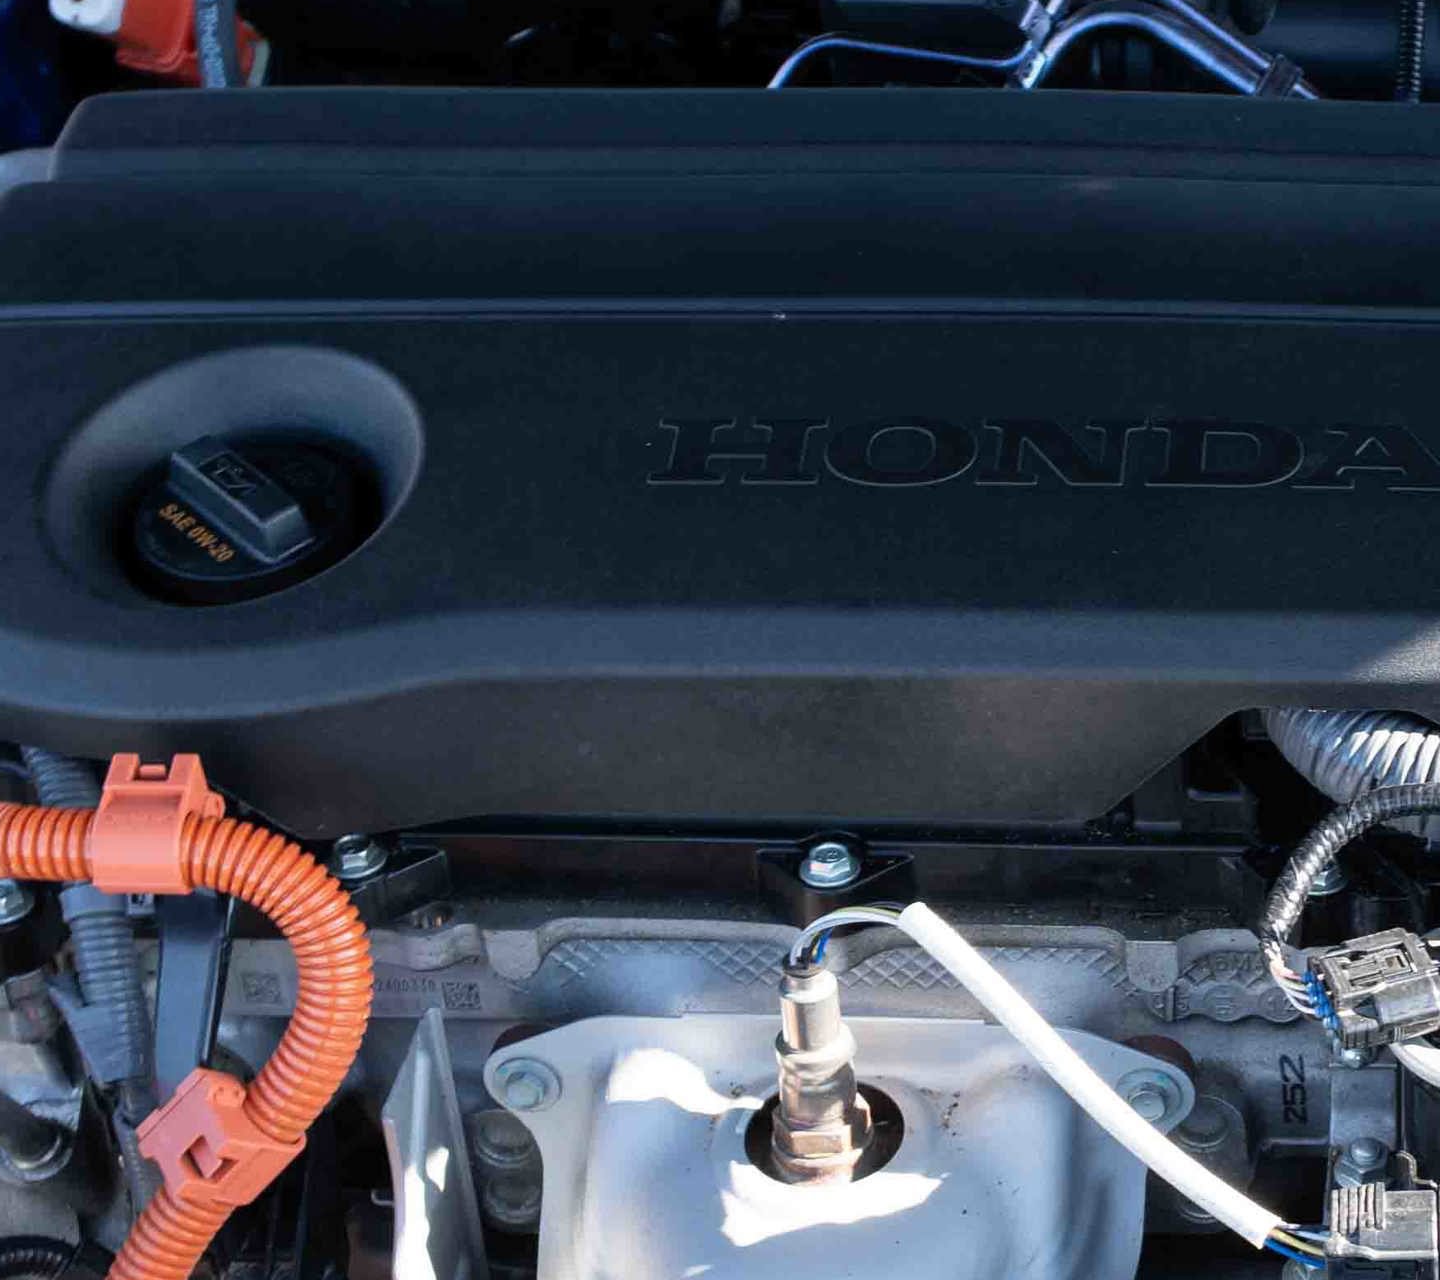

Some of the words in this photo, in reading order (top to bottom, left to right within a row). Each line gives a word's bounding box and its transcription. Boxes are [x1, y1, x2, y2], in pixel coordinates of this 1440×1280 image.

[159, 503, 196, 531] SAE
[186, 524, 236, 562] 0W-20
[1279, 1053, 1307, 1125] 252
